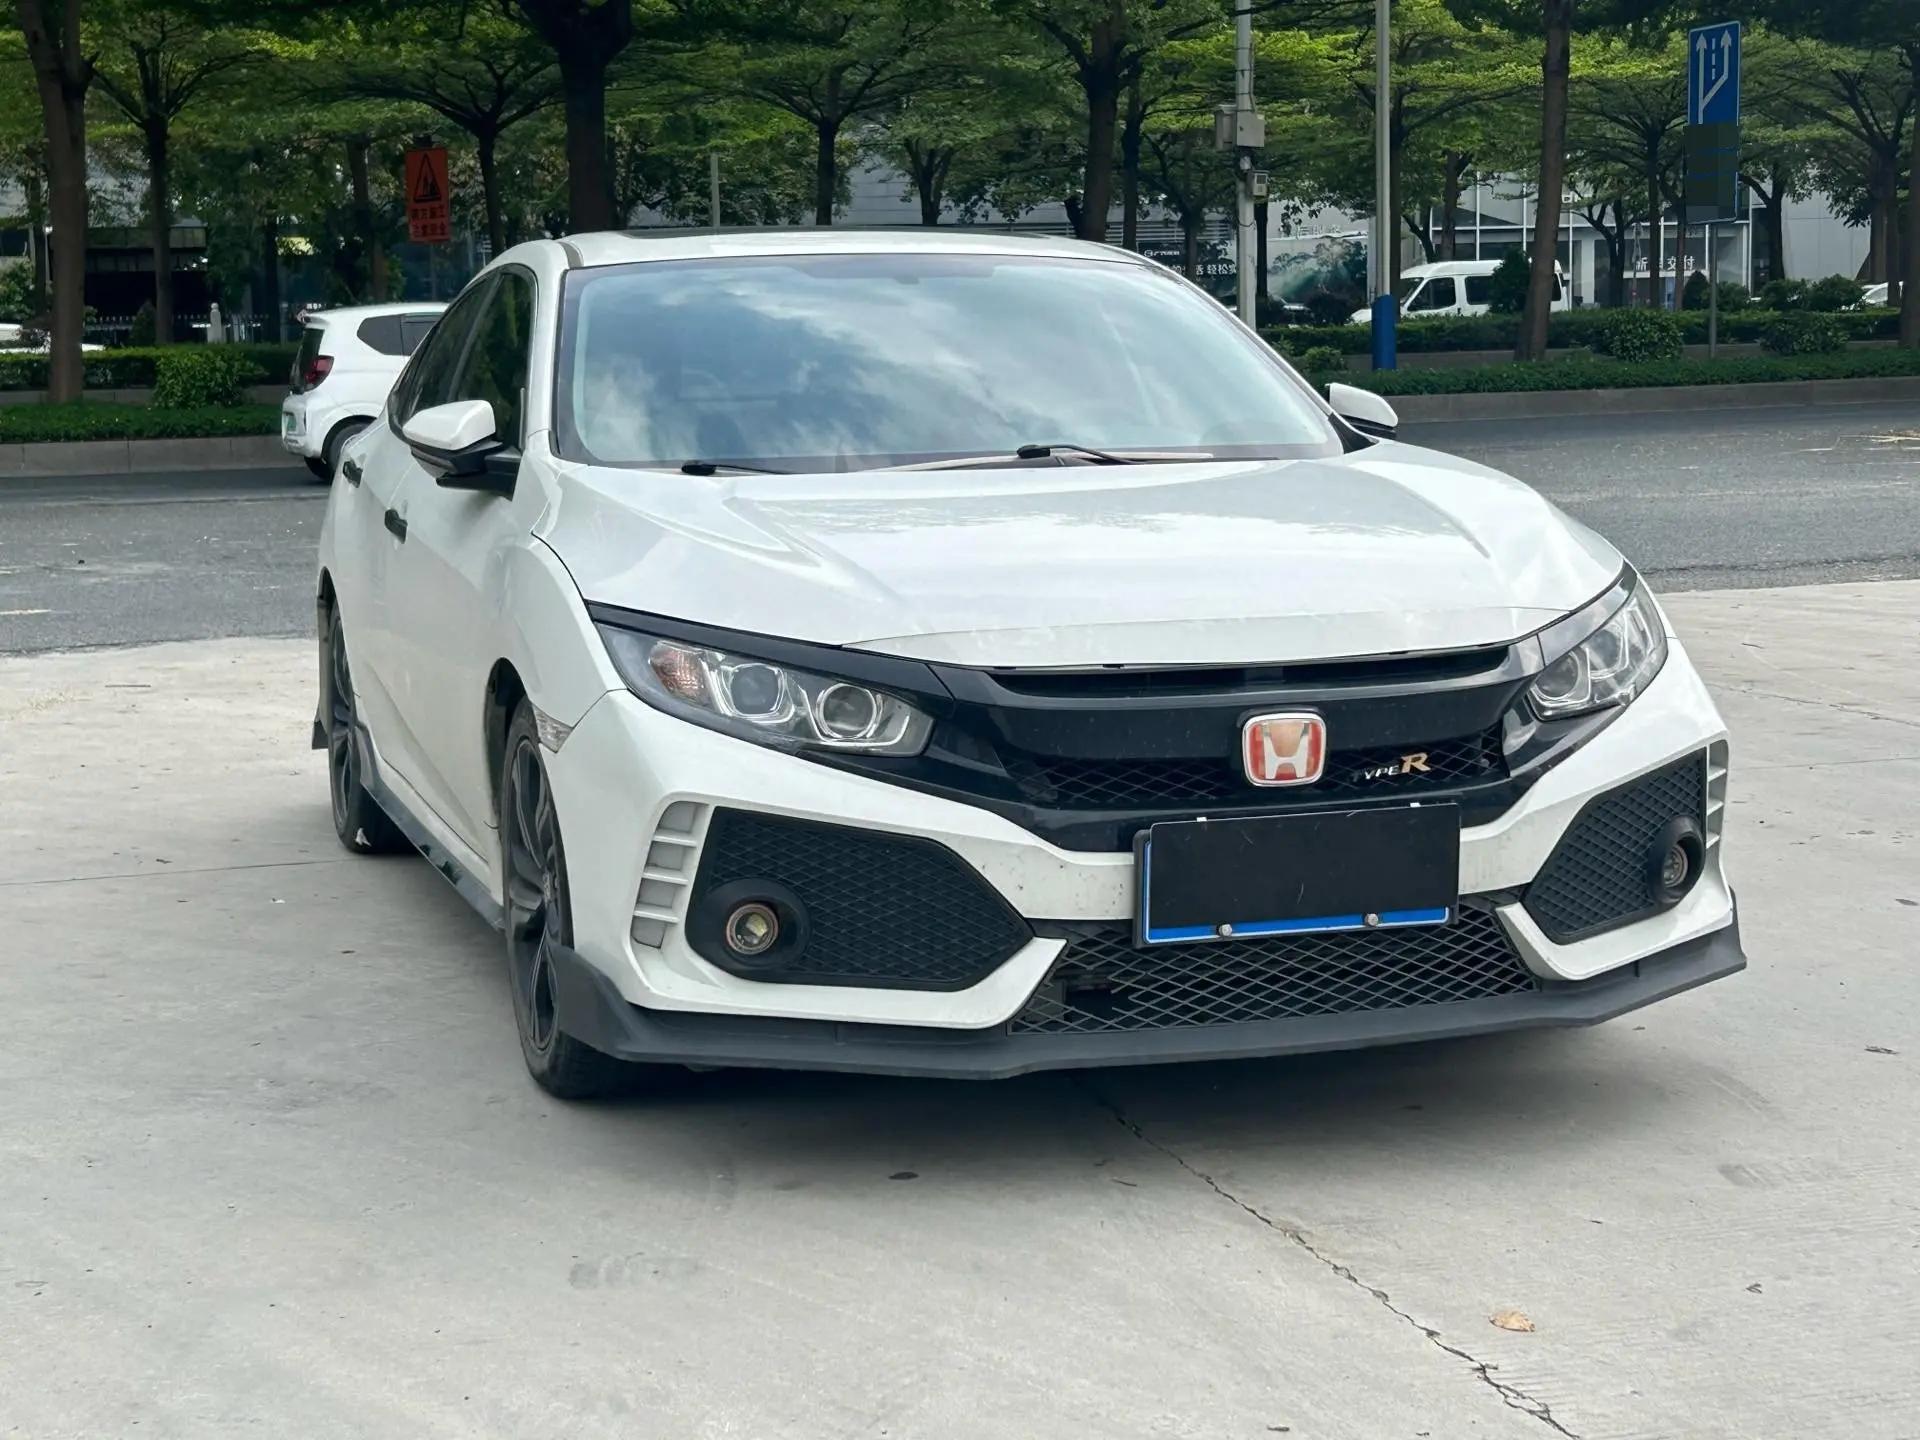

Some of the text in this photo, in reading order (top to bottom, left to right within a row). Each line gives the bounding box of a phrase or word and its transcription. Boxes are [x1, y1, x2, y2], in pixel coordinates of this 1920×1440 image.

[1635, 255, 1696, 271] 新交付
[1400, 752, 1432, 773] R
